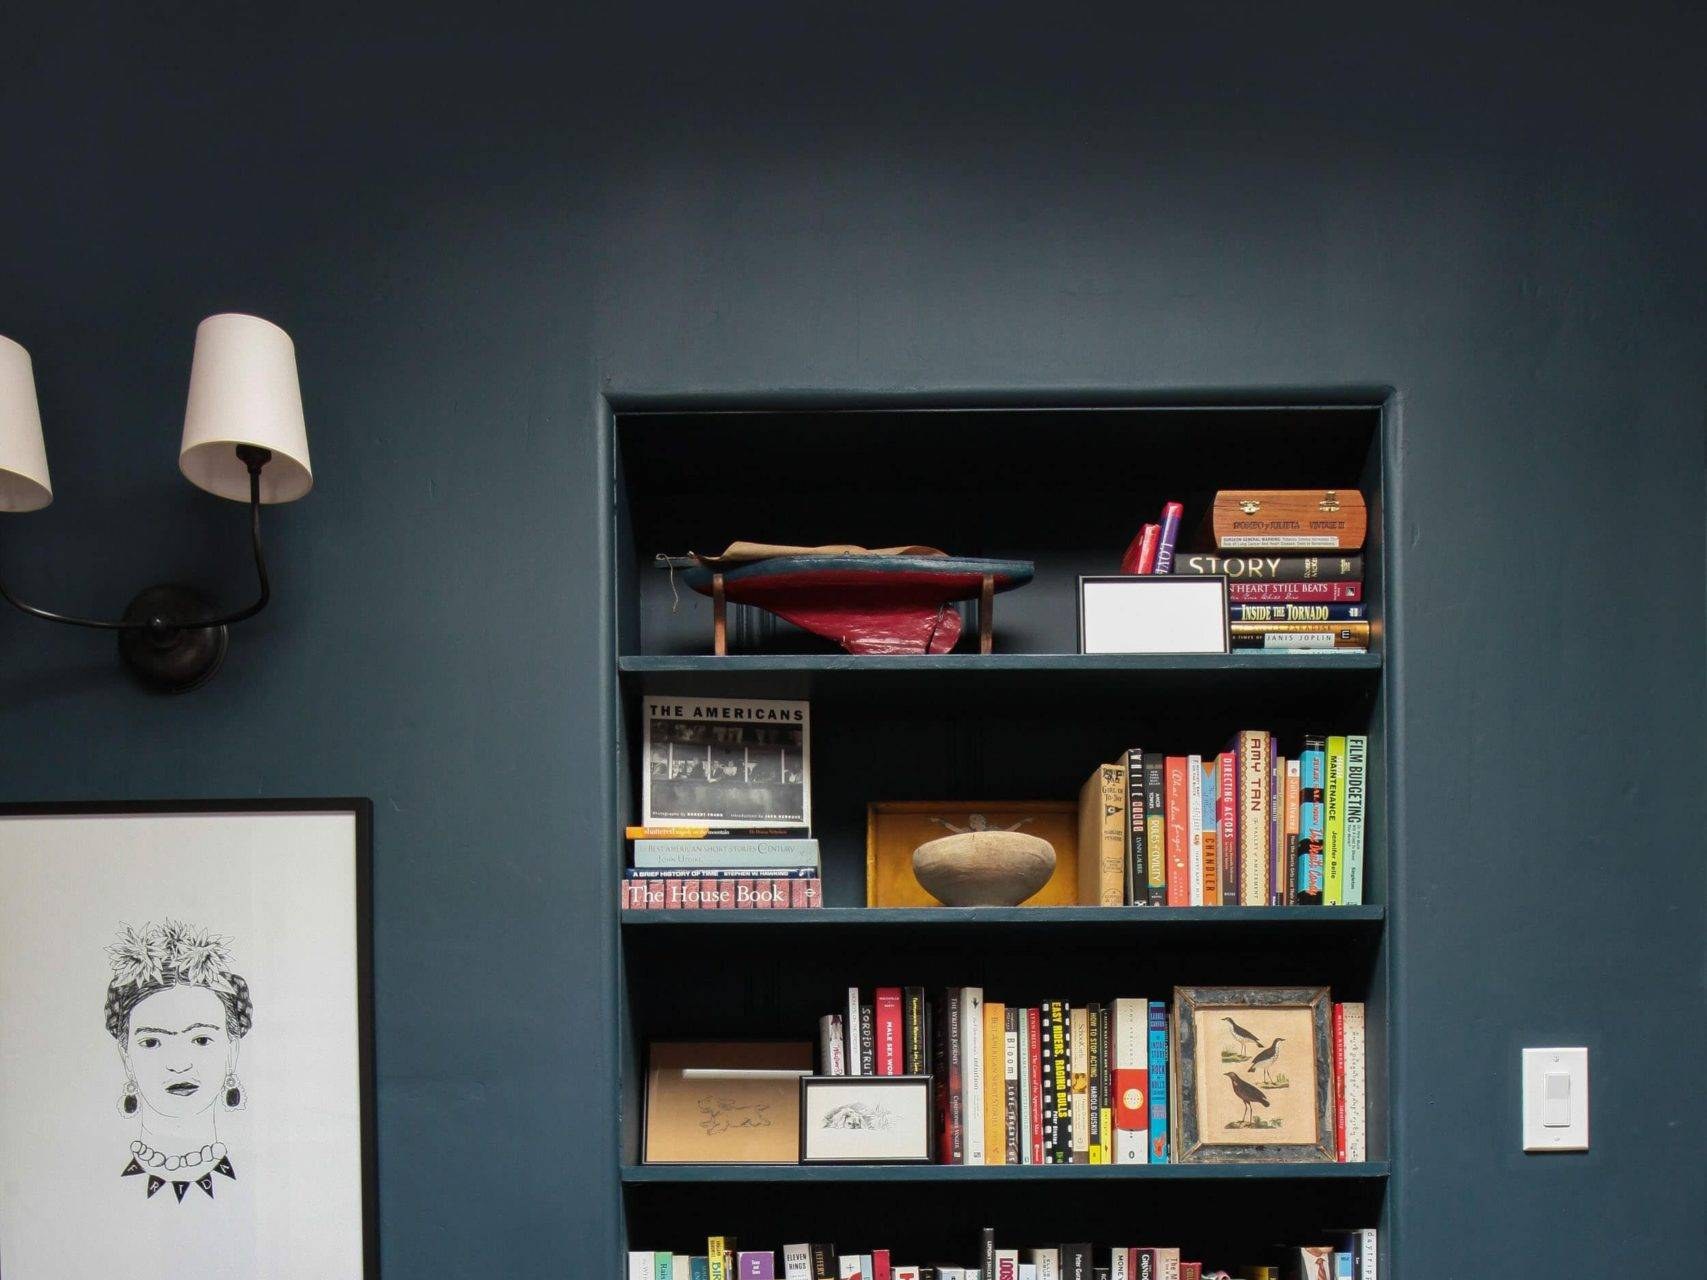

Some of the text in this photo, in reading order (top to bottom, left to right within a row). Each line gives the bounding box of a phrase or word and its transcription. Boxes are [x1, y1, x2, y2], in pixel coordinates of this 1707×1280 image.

[1188, 557, 1282, 579] STORY
[1272, 583, 1299, 593] STILL
[1301, 583, 1329, 593] BEATS
[1241, 604, 1330, 621] INSIDE THE TORNADO
[1267, 634, 1332, 643] JANIS JOPLIN
[649, 704, 805, 721] THE AMERICANS
[1223, 757, 1233, 803] DIRECTING
[1250, 738, 1261, 812] AMY TAN
[1347, 738, 1363, 824] FILM BUDGETING
[1289, 779, 1298, 799] Julia
[1328, 755, 1337, 821] MAINTENANCE
[1223, 806, 1234, 839] ACTORS
[633, 870, 639, 878] A
[639, 870, 660, 878] BRIEF
[660, 870, 691, 878] HISTORY
[691, 870, 700, 878] OF
[700, 870, 719, 878] TIME
[1204, 838, 1215, 893] CHANDLER
[629, 884, 785, 904] The House Book
[886, 1021, 894, 1058] MALE SEX
[1090, 1027, 1097, 1037] TO
[862, 1049, 873, 1075] TRUT
[1007, 1037, 1016, 1075] Bloom
[1052, 1002, 1067, 1119] EASY RIDERS, RAGING BULLS
[1008, 1086, 1016, 1107] LOVE
[786, 1254, 807, 1262] ELEVEN
[789, 1263, 807, 1271] RINGS
[1075, 1253, 1083, 1267] Peter
[1170, 1258, 1178, 1270] The
